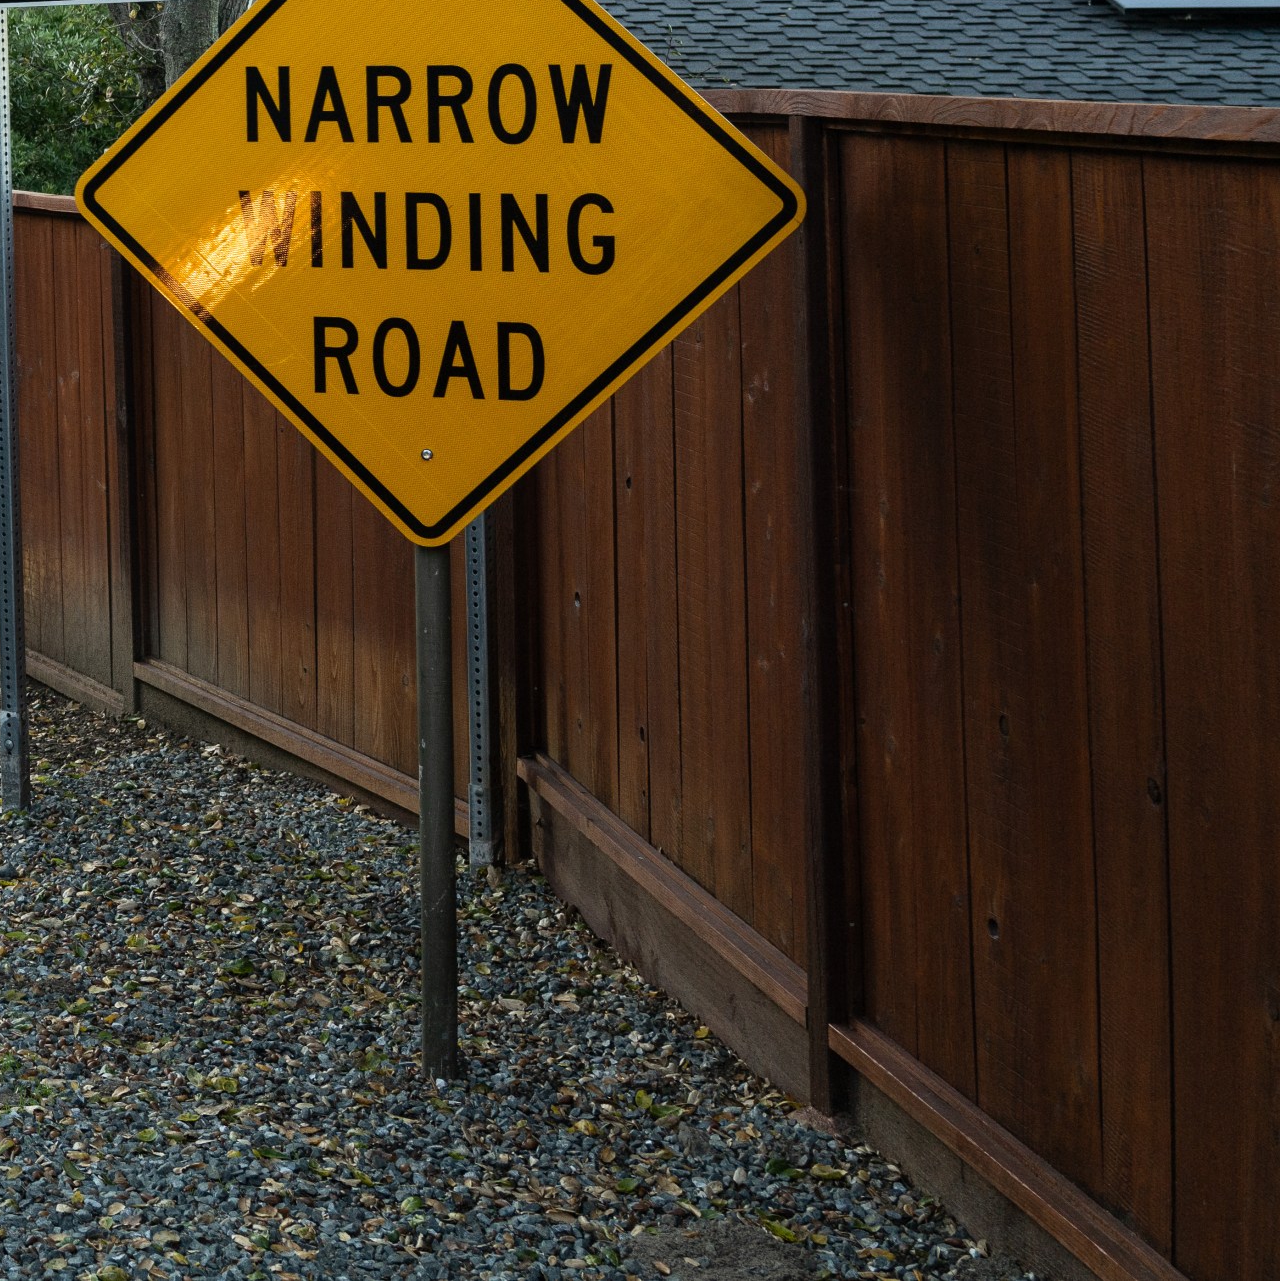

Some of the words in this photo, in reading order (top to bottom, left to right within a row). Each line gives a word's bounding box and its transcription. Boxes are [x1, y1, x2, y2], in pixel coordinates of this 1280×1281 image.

[244, 62, 613, 145] NARROW
[237, 189, 616, 276] WINDING
[311, 315, 546, 402] ROAD
